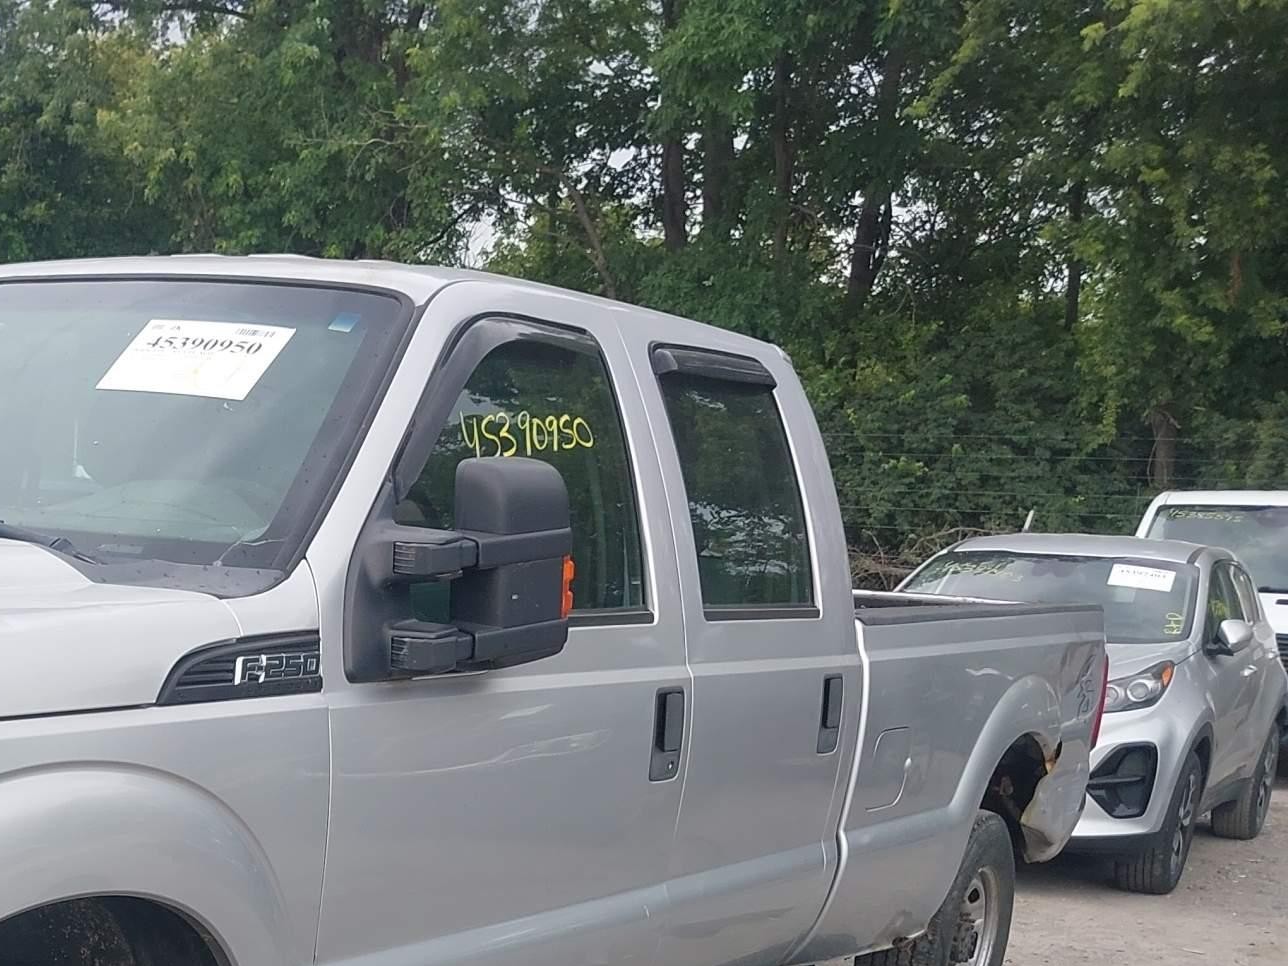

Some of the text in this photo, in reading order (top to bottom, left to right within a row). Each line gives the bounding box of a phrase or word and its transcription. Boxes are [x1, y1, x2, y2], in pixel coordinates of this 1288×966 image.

[146, 335, 263, 356] 45390950
[460, 411, 594, 459] 45390950
[233, 650, 321, 686] F-250
